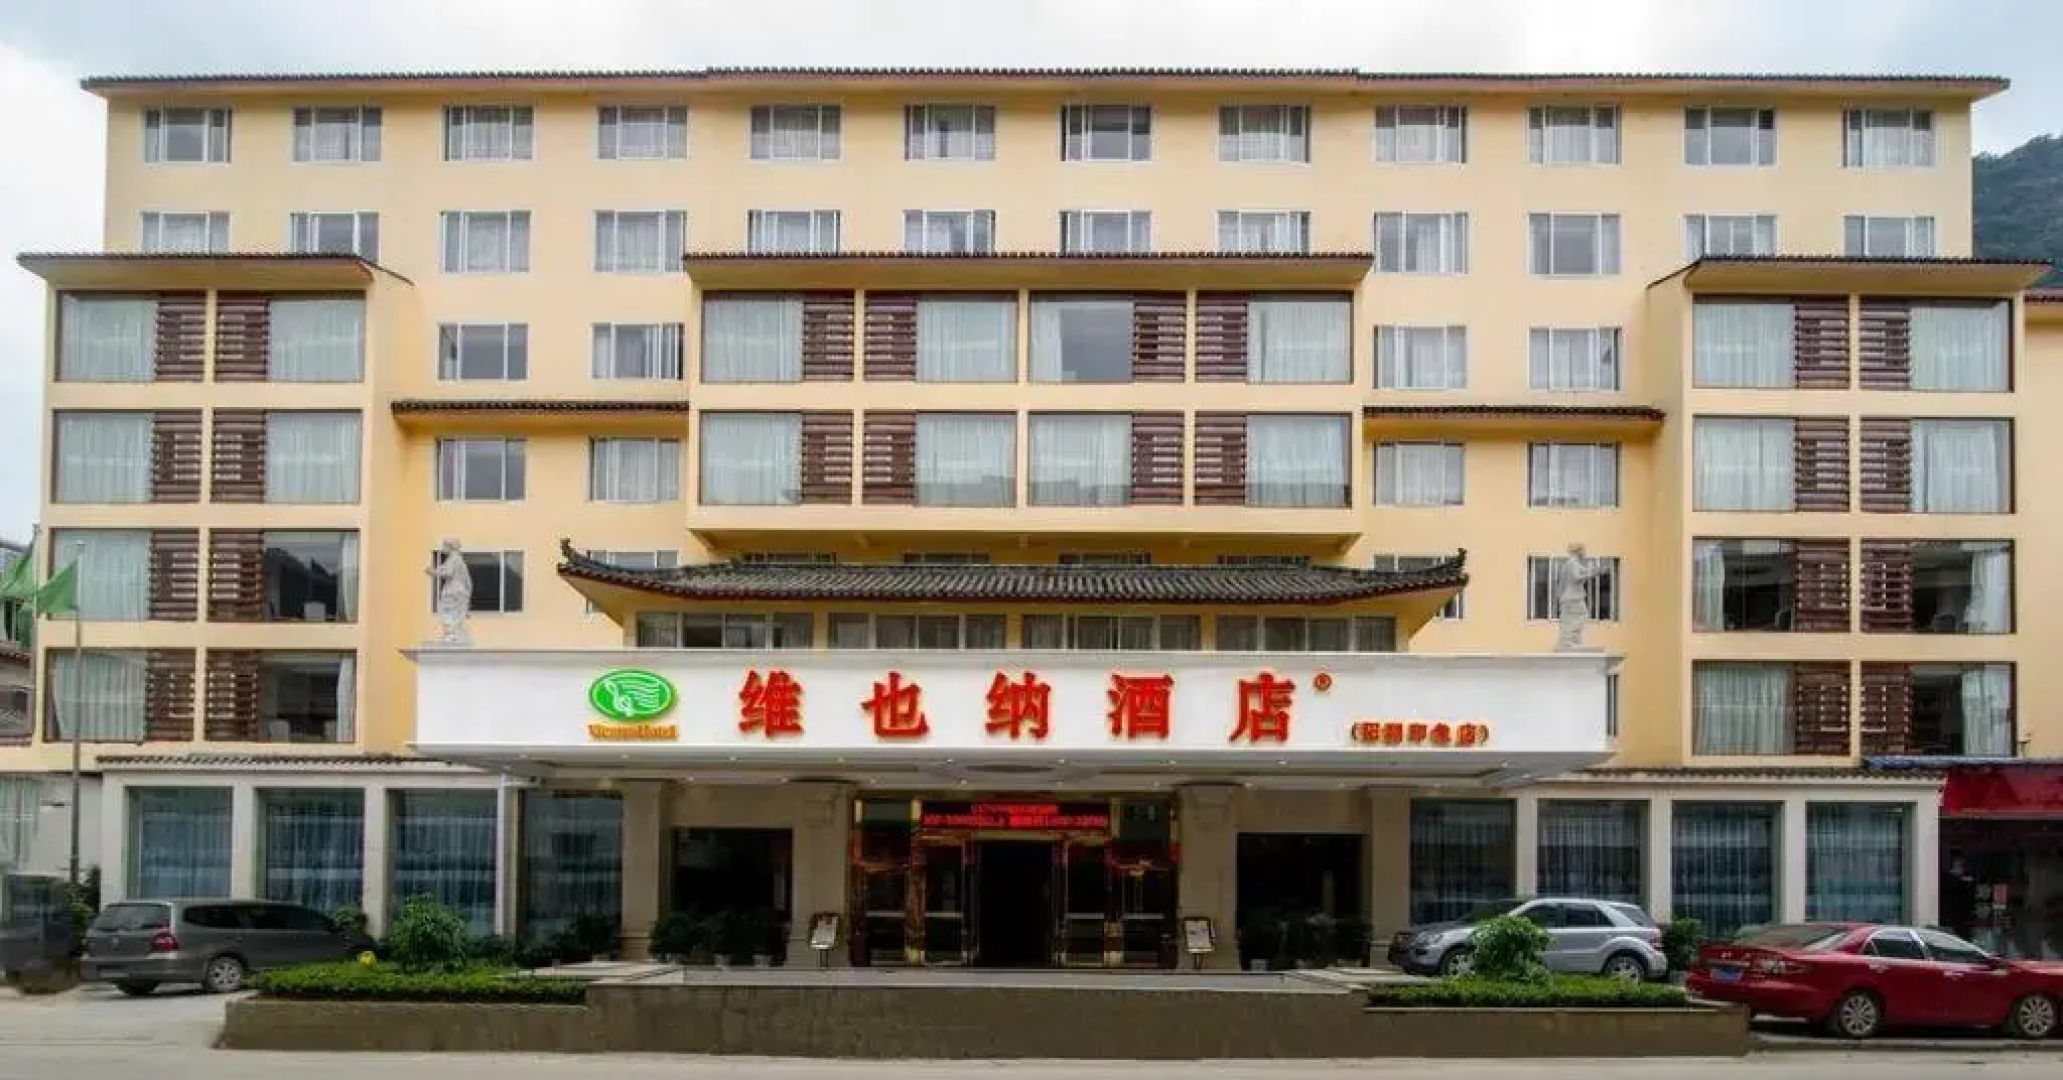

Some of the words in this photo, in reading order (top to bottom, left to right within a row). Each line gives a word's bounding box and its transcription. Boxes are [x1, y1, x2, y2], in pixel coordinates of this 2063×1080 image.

[739, 670, 1295, 742] 维也纳酒店
